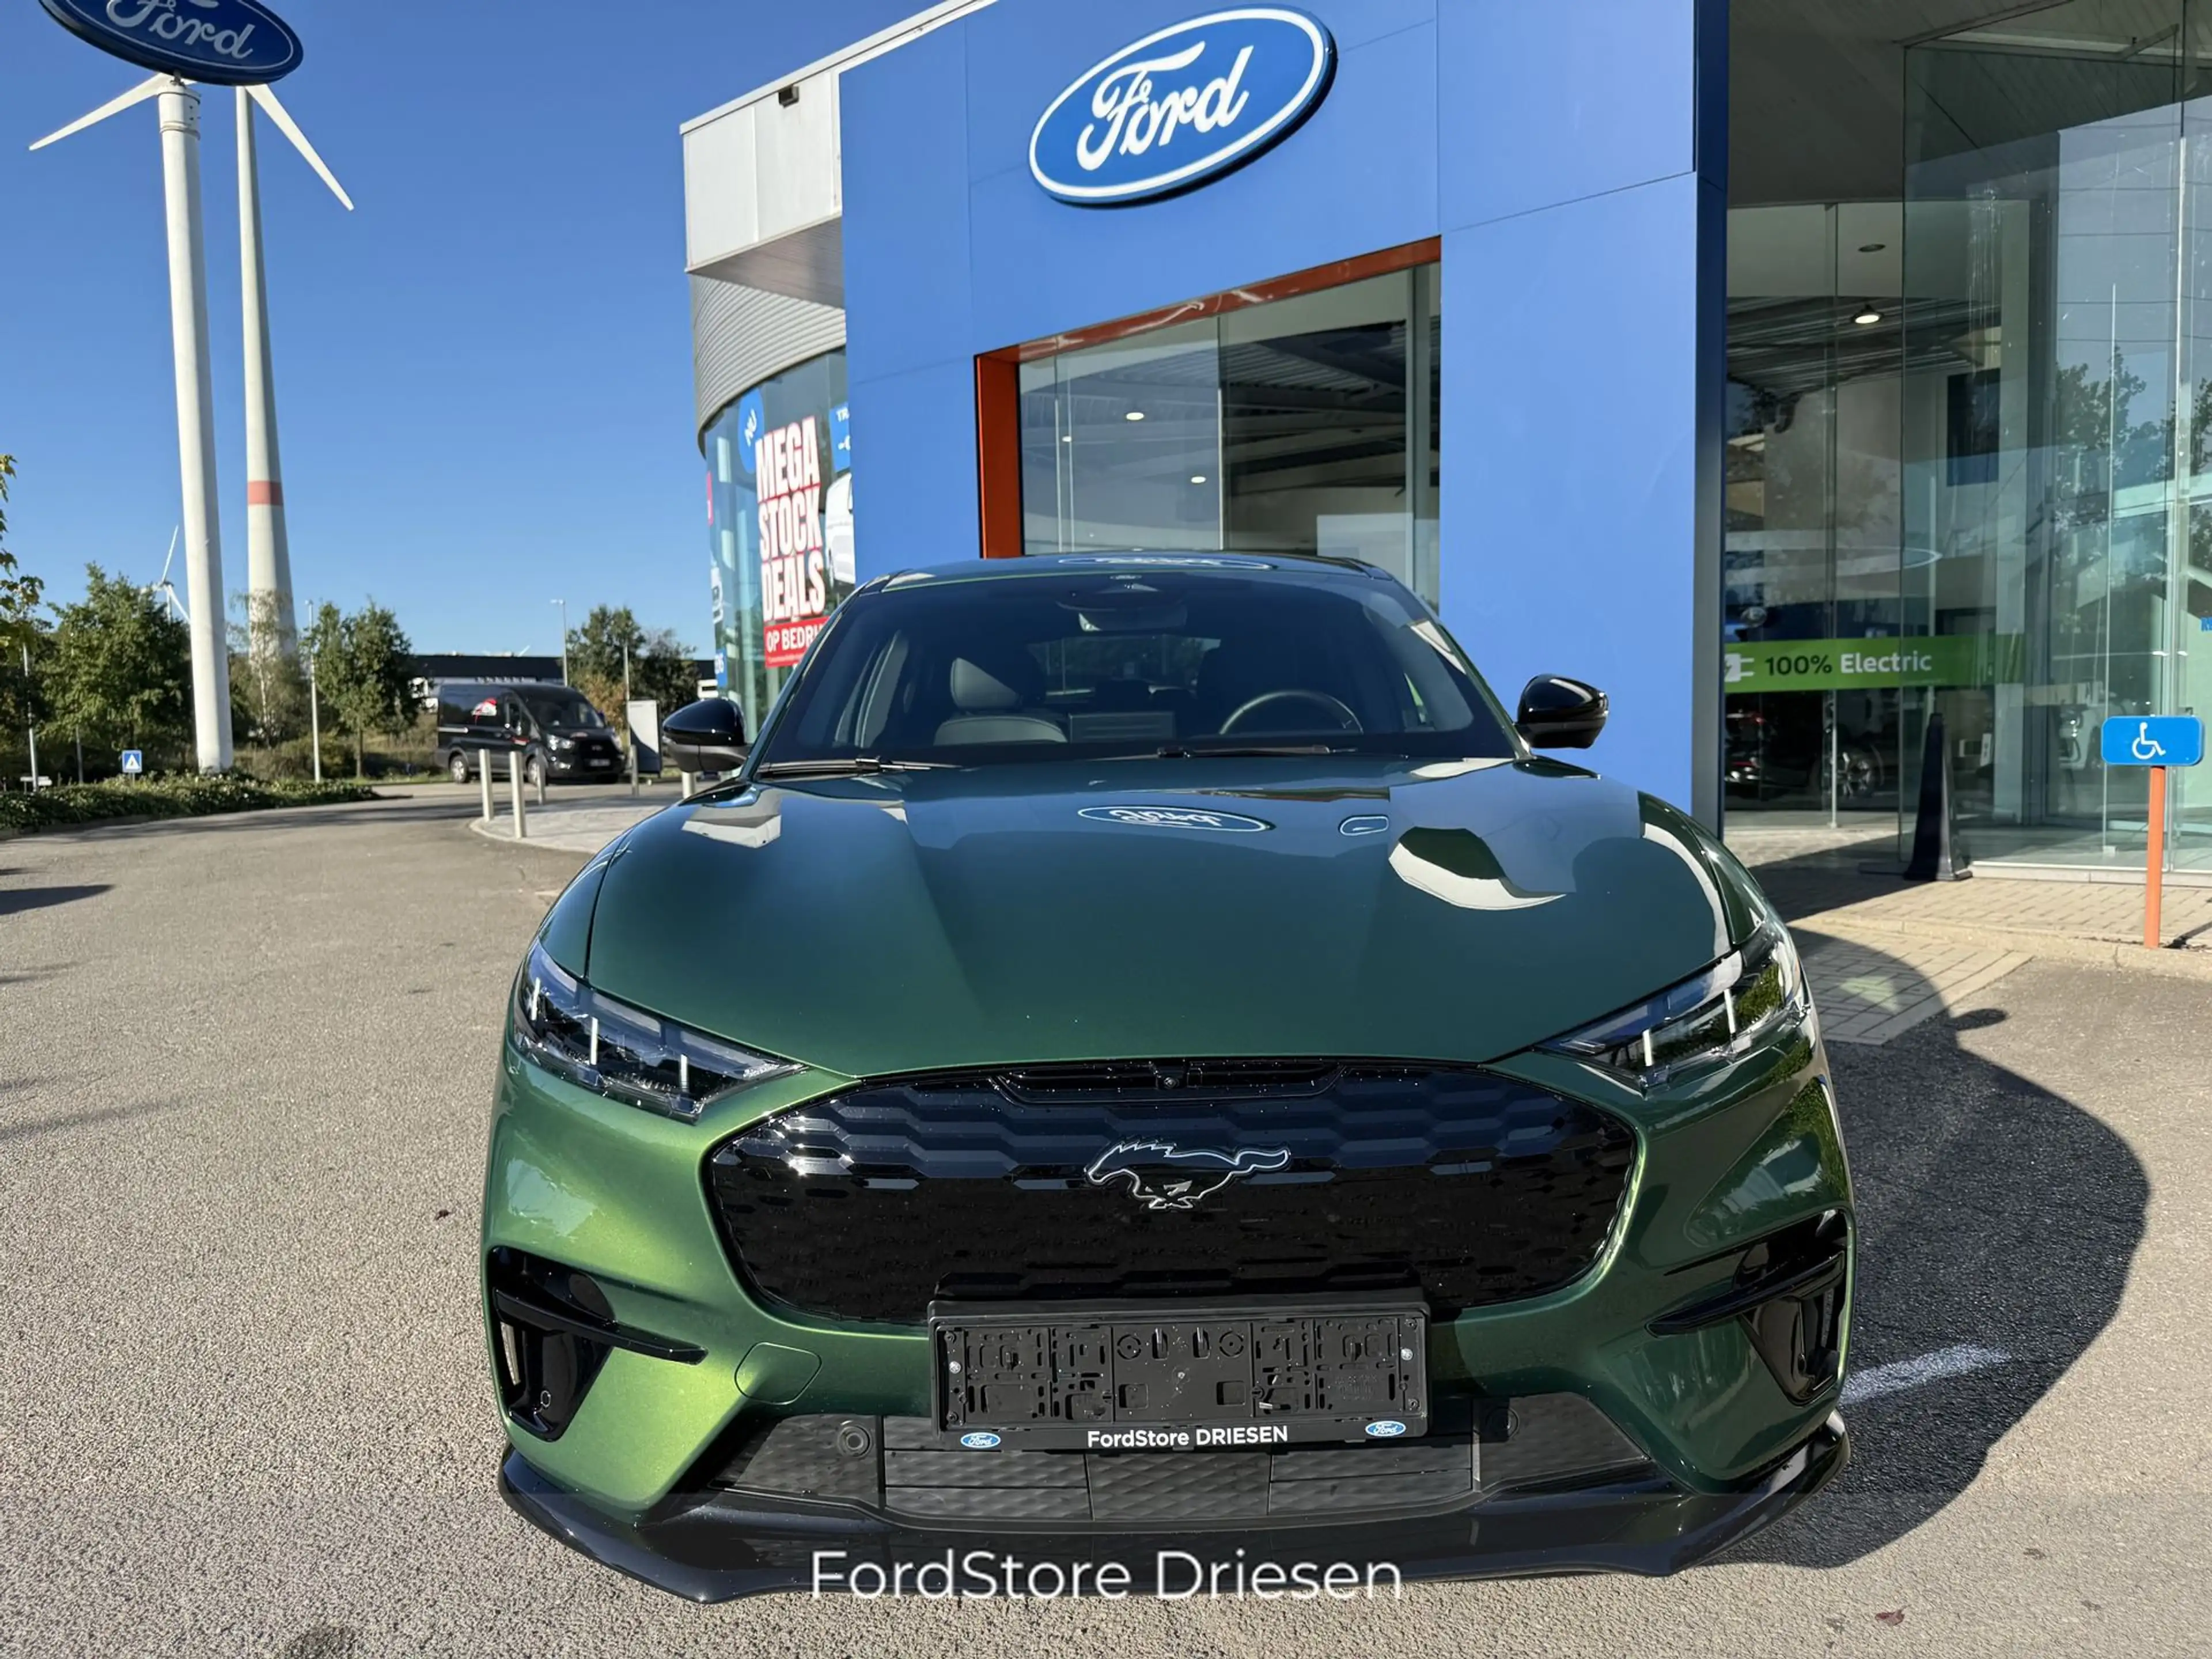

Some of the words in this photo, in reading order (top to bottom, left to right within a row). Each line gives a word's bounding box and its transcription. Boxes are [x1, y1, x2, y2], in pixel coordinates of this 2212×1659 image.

[1076, 41, 1253, 171] Ford
[755, 416, 820, 502] MEGA
[758, 486, 822, 559] STOCK
[762, 548, 825, 623] DEALS
[767, 630, 779, 652] OP
[782, 624, 823, 650] BEDRI
[1764, 655, 1832, 675] 100%
[1841, 651, 1931, 673] Electric
[1088, 1430, 1189, 1447] FordStore
[1196, 1425, 1287, 1445] DRIESEN
